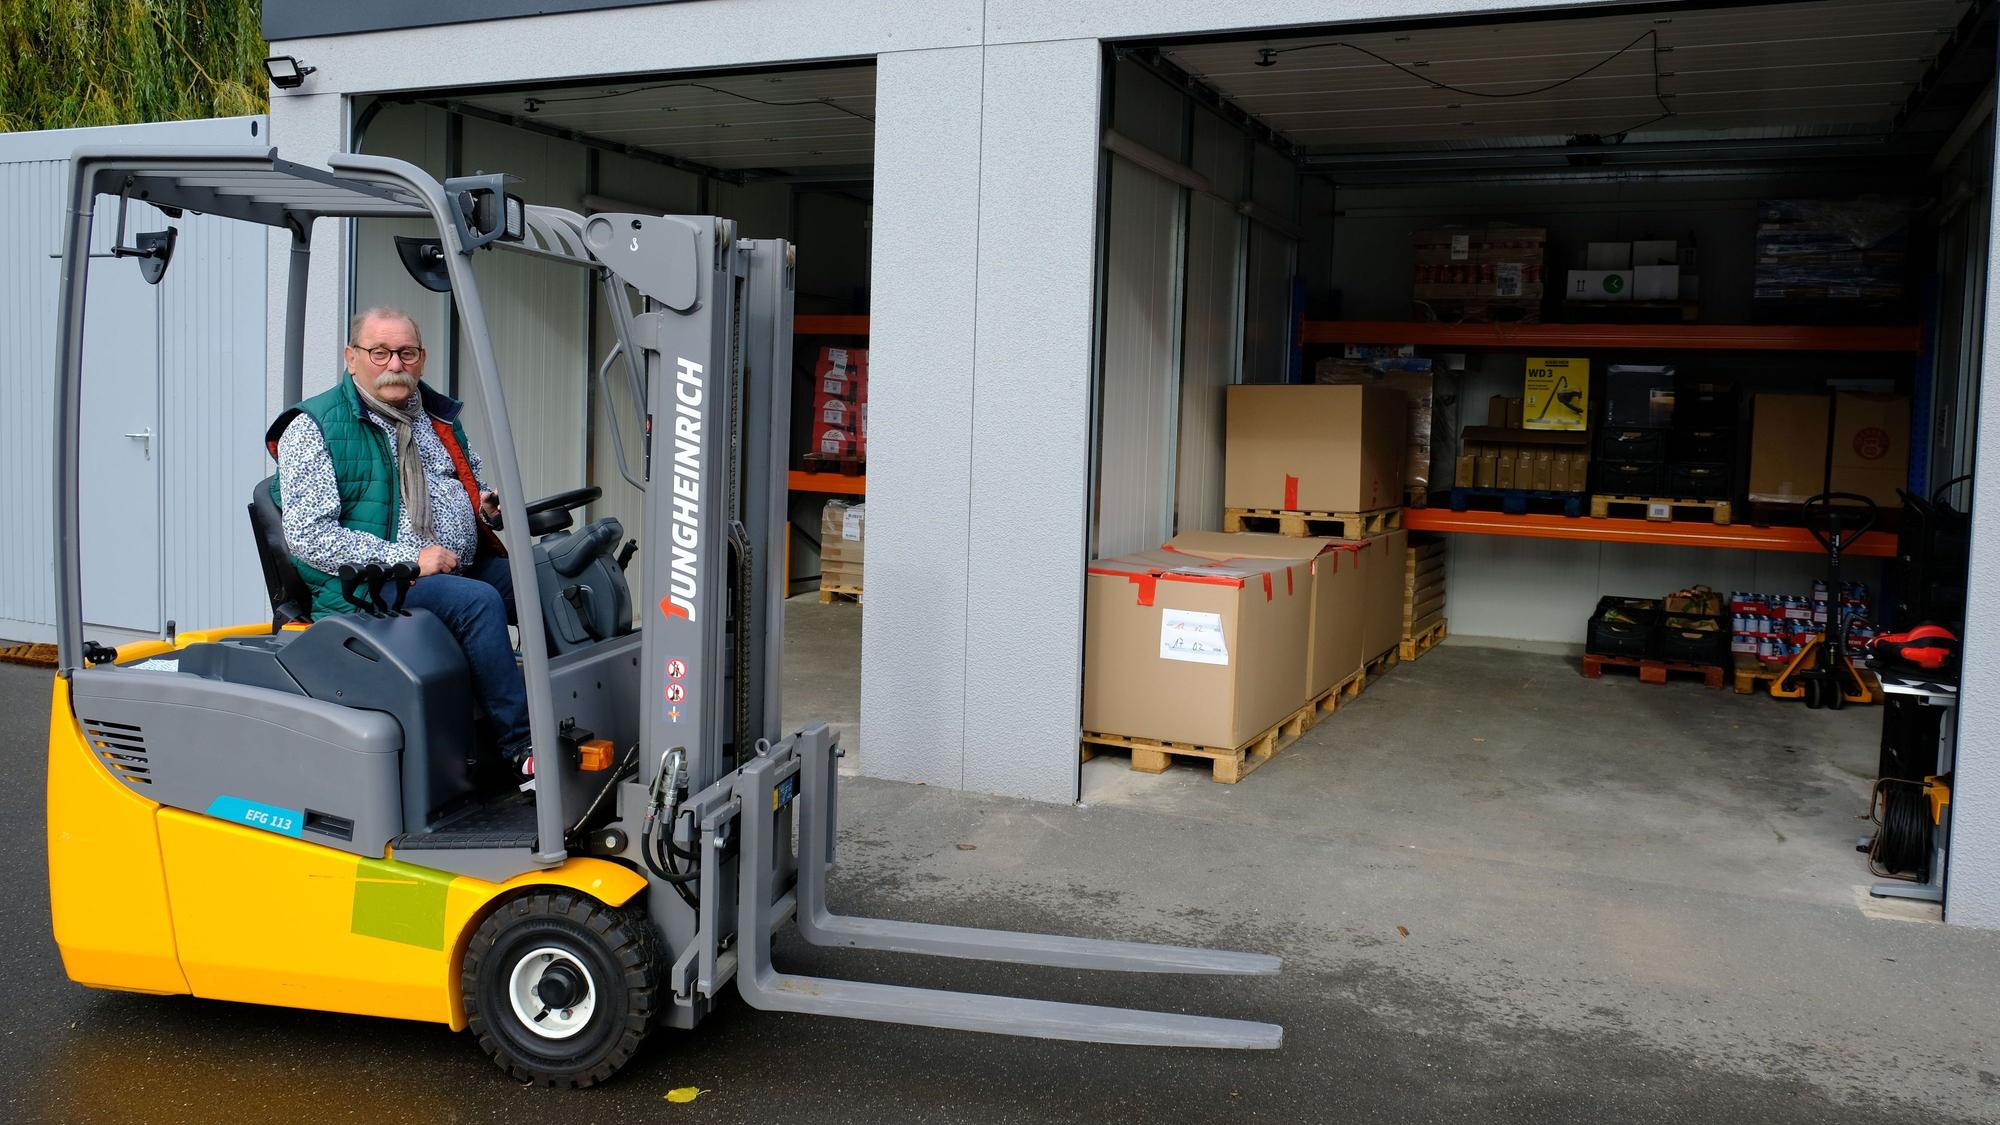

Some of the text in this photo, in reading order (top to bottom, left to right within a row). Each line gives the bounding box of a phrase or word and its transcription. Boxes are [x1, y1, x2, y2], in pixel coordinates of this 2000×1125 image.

[660, 357, 703, 622] JUNGHEINRICH
[245, 809, 292, 830] EFG 113
